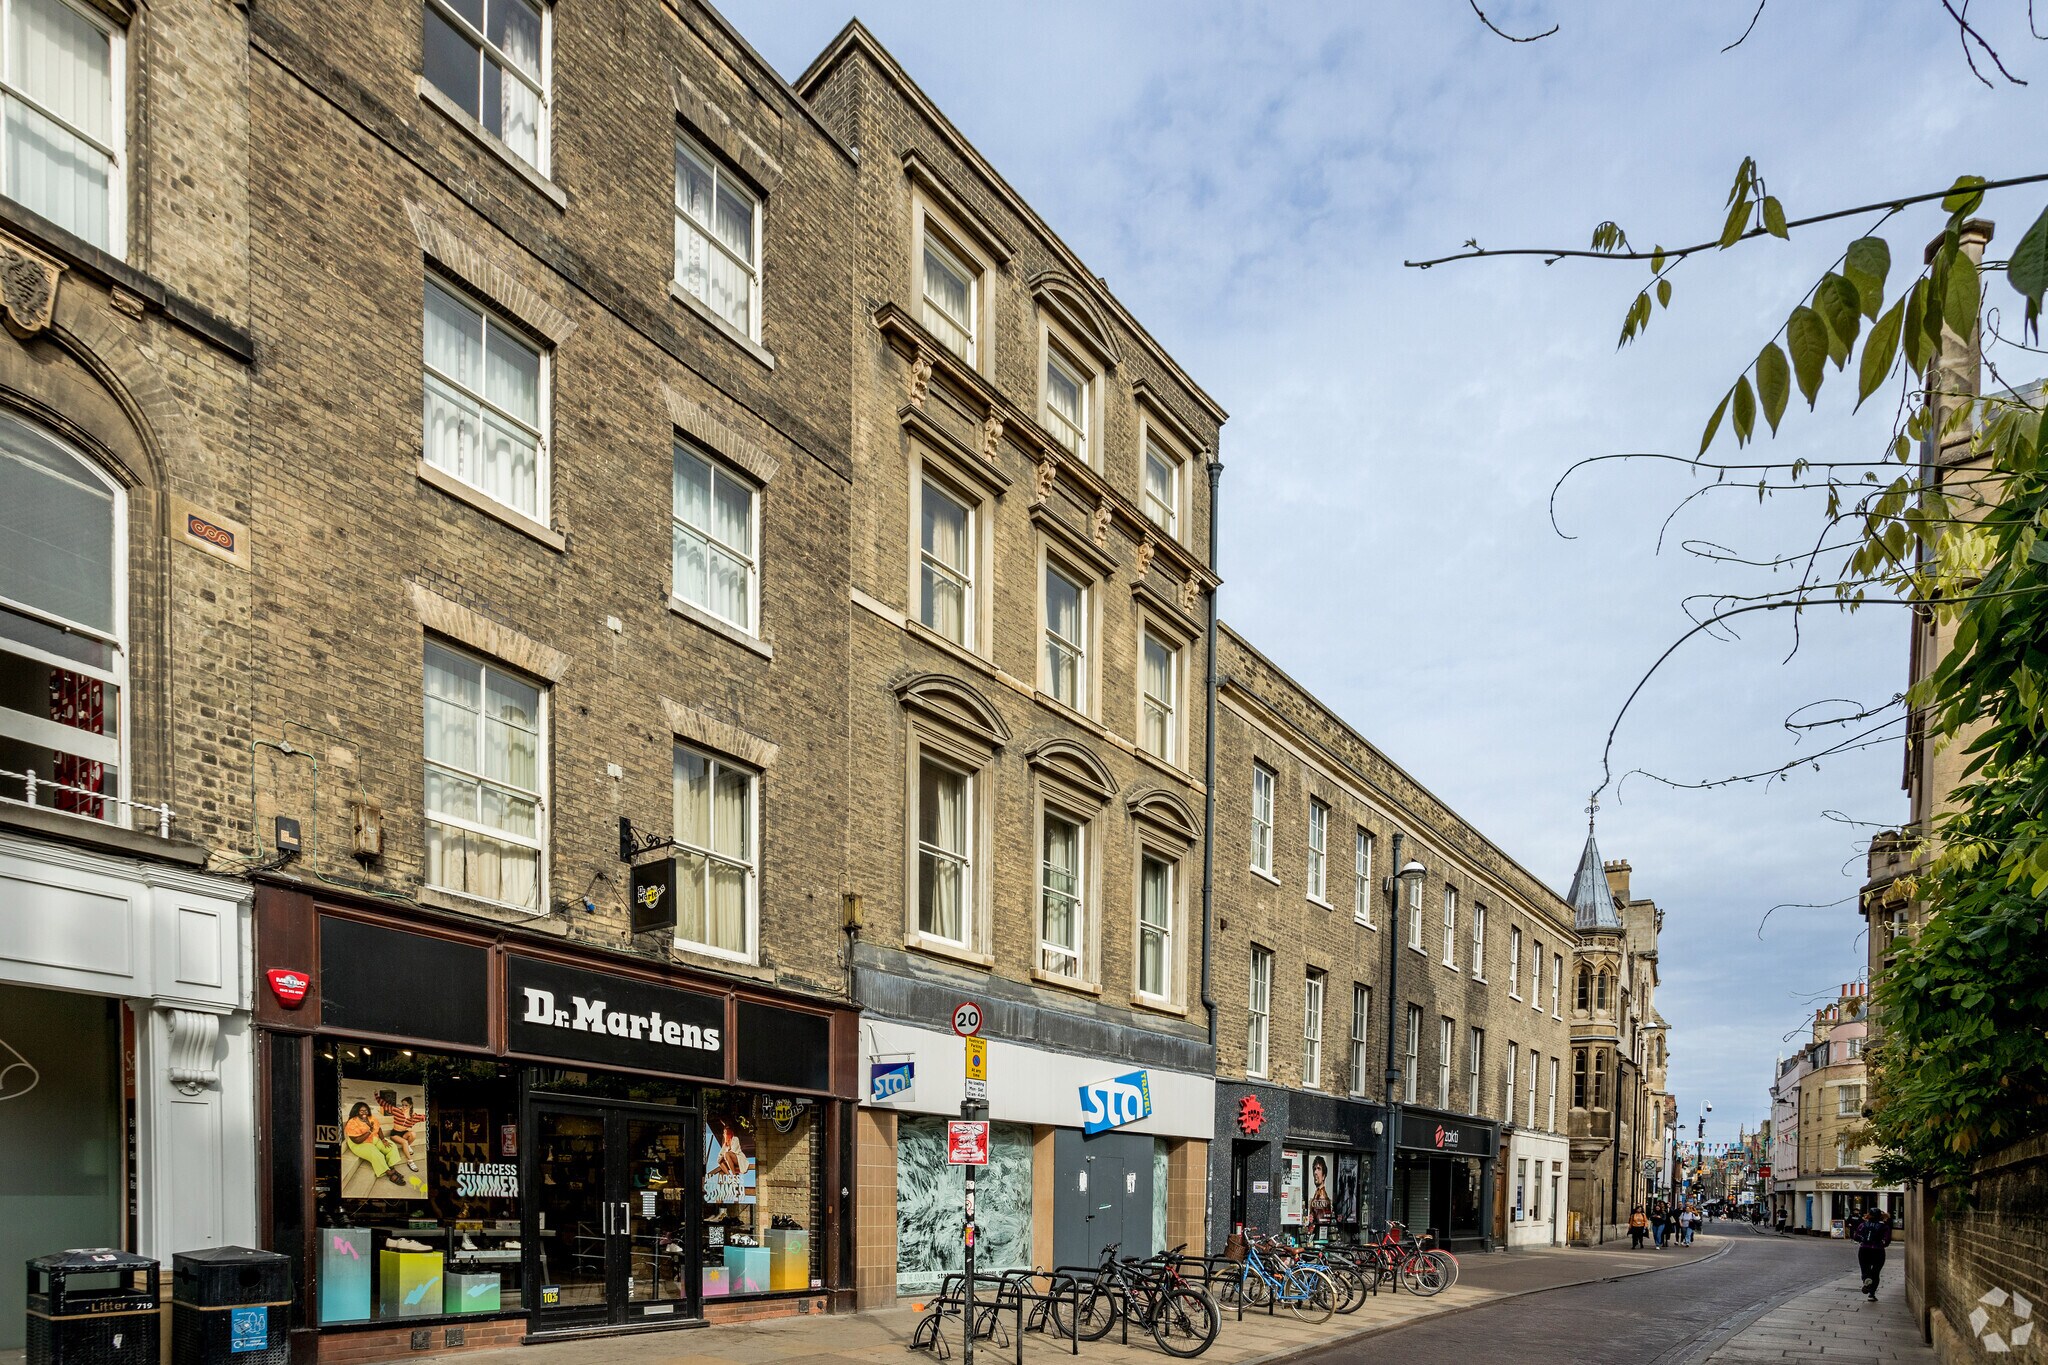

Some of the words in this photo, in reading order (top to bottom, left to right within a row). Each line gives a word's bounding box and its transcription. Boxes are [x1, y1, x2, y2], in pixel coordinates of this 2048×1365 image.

[957, 1011, 978, 1027] 20
[874, 1073, 906, 1096] sta
[1140, 1072, 1151, 1114] TRAVEL
[1083, 1080, 1144, 1126] sta
[458, 1162, 476, 1174] ALL
[479, 1163, 517, 1176] ACCESS
[456, 1174, 519, 1198] SUMMER
[703, 1183, 746, 1202] SUMMER
[91, 1301, 128, 1312] Litter
[136, 1302, 153, 1310] 719
